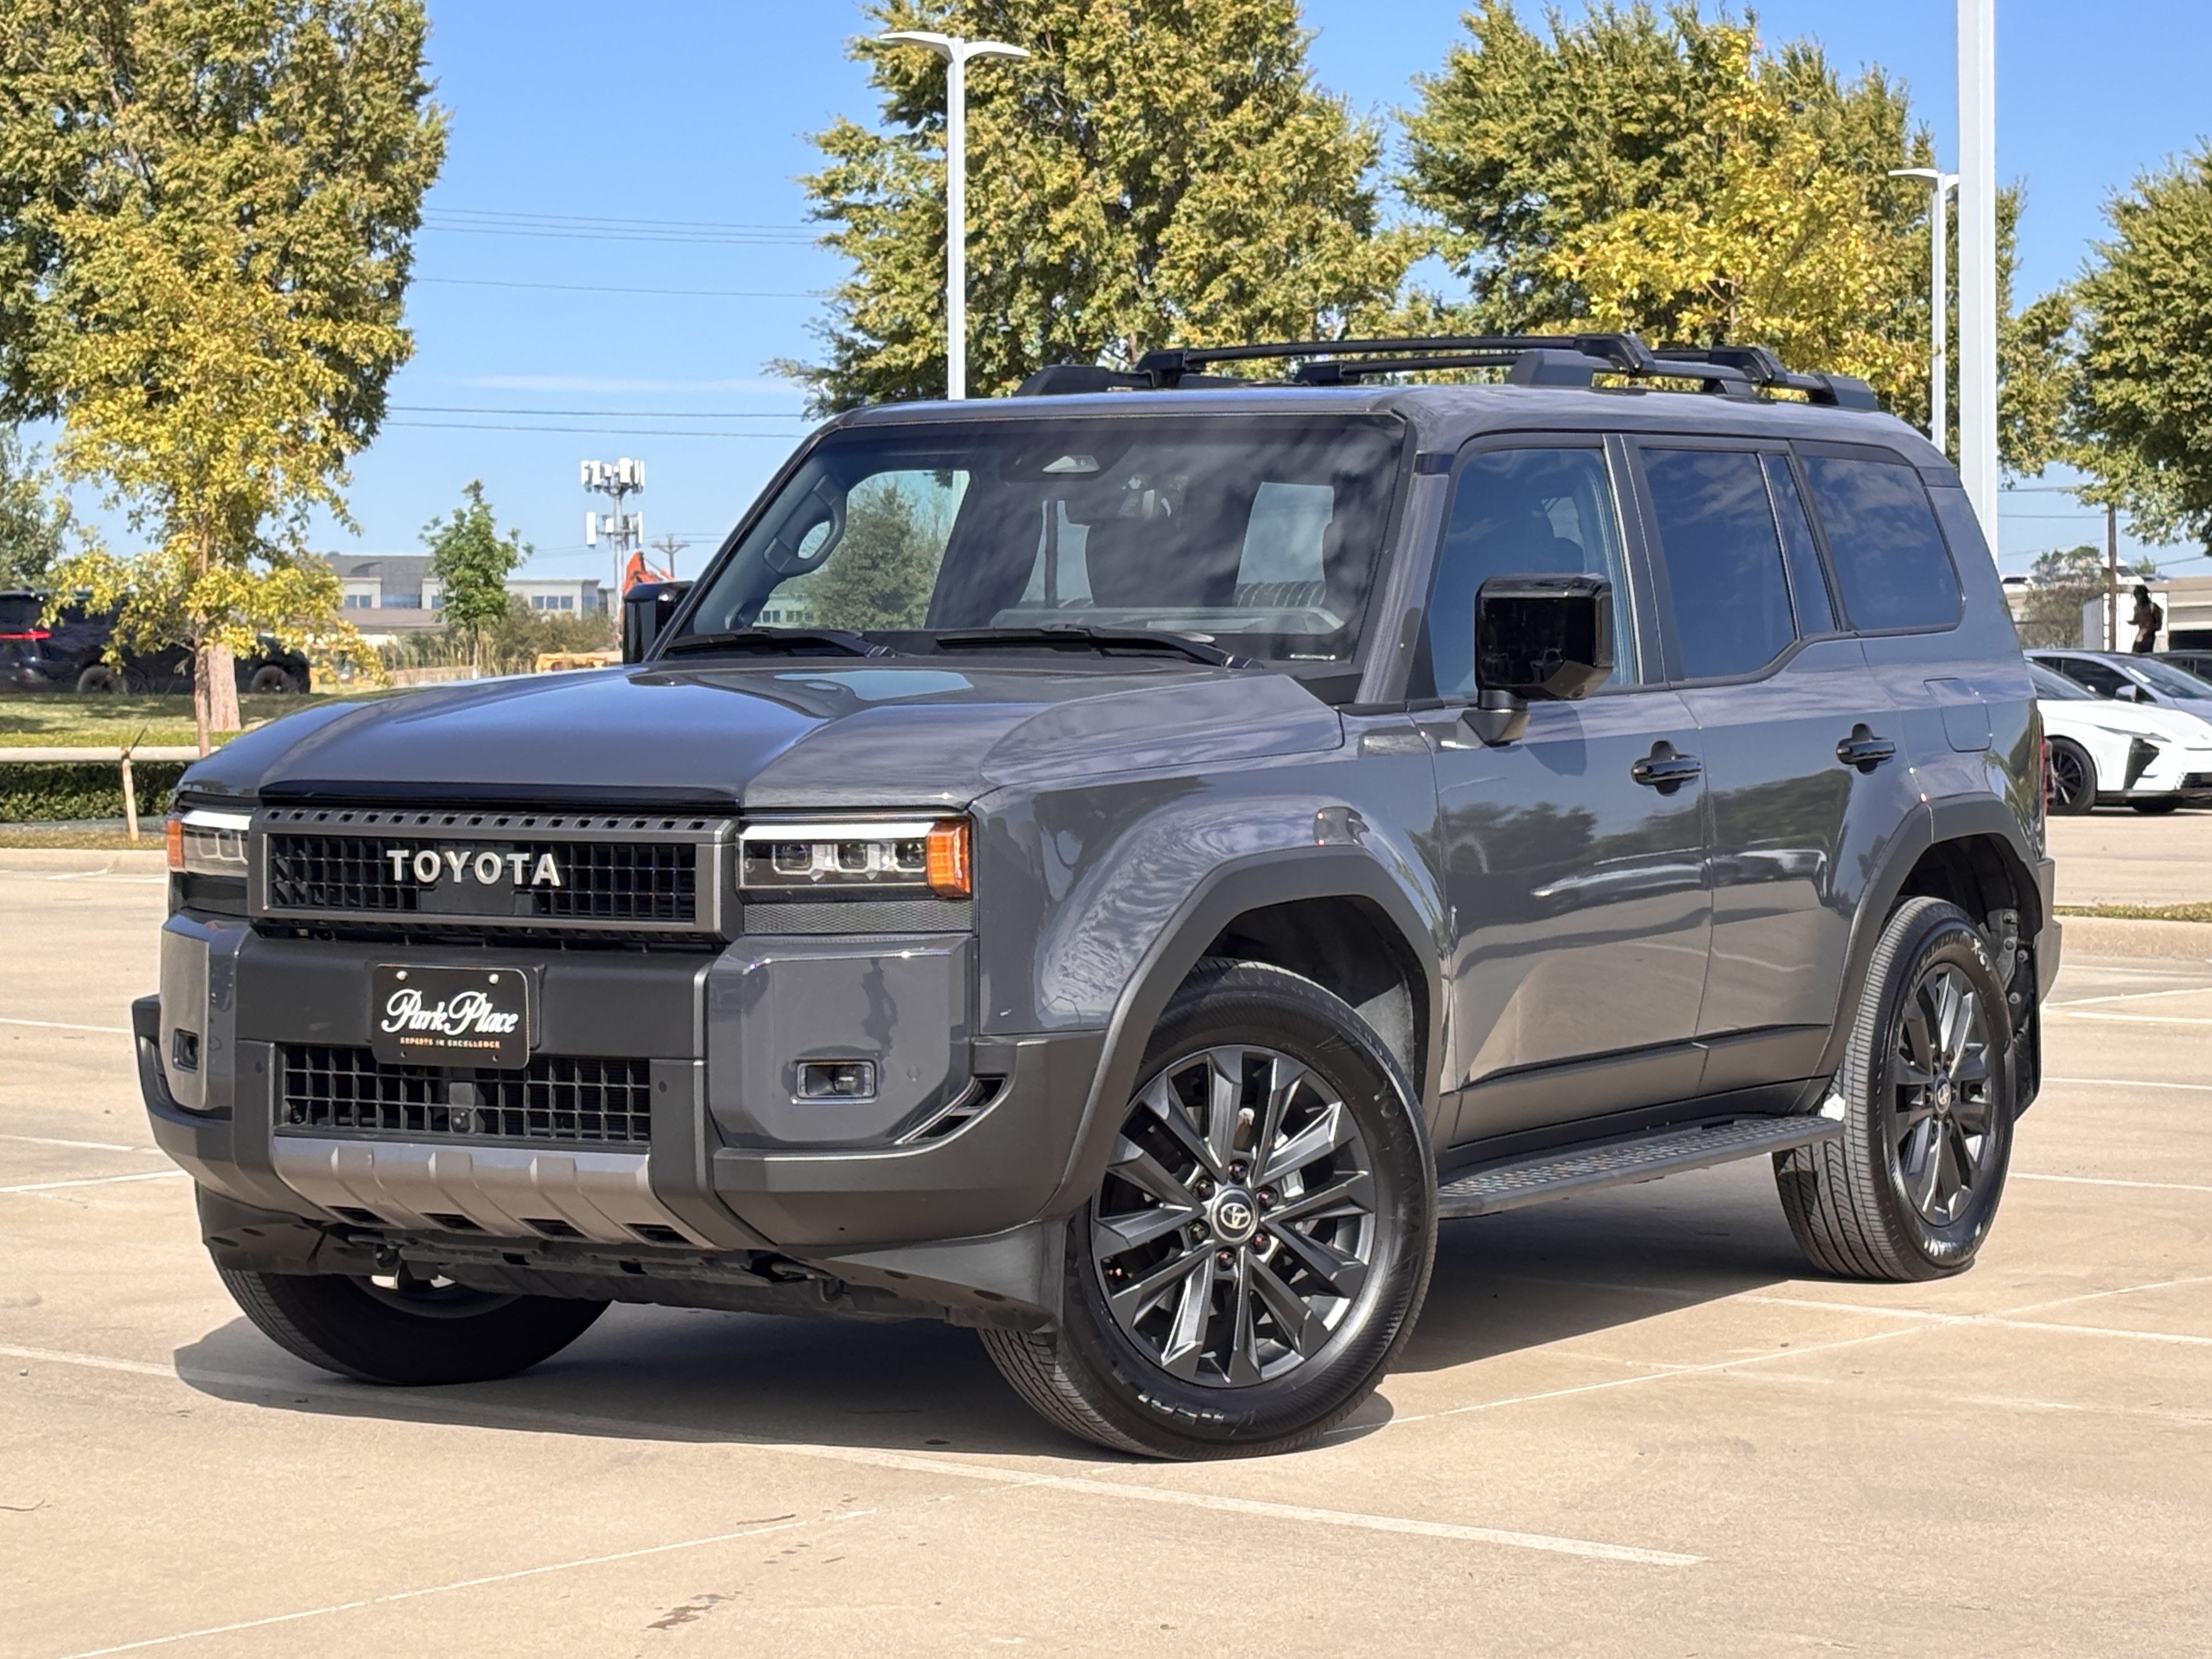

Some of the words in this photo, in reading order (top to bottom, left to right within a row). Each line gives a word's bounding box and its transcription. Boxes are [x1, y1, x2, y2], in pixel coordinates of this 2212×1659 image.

[386, 849, 561, 887] TOYOTA
[381, 989, 448, 1033] Park
[444, 991, 519, 1035] Place
[400, 1037, 434, 1046] EXPERTS
[436, 1039, 445, 1047] IN
[447, 1039, 501, 1049] EXCELLENCE
